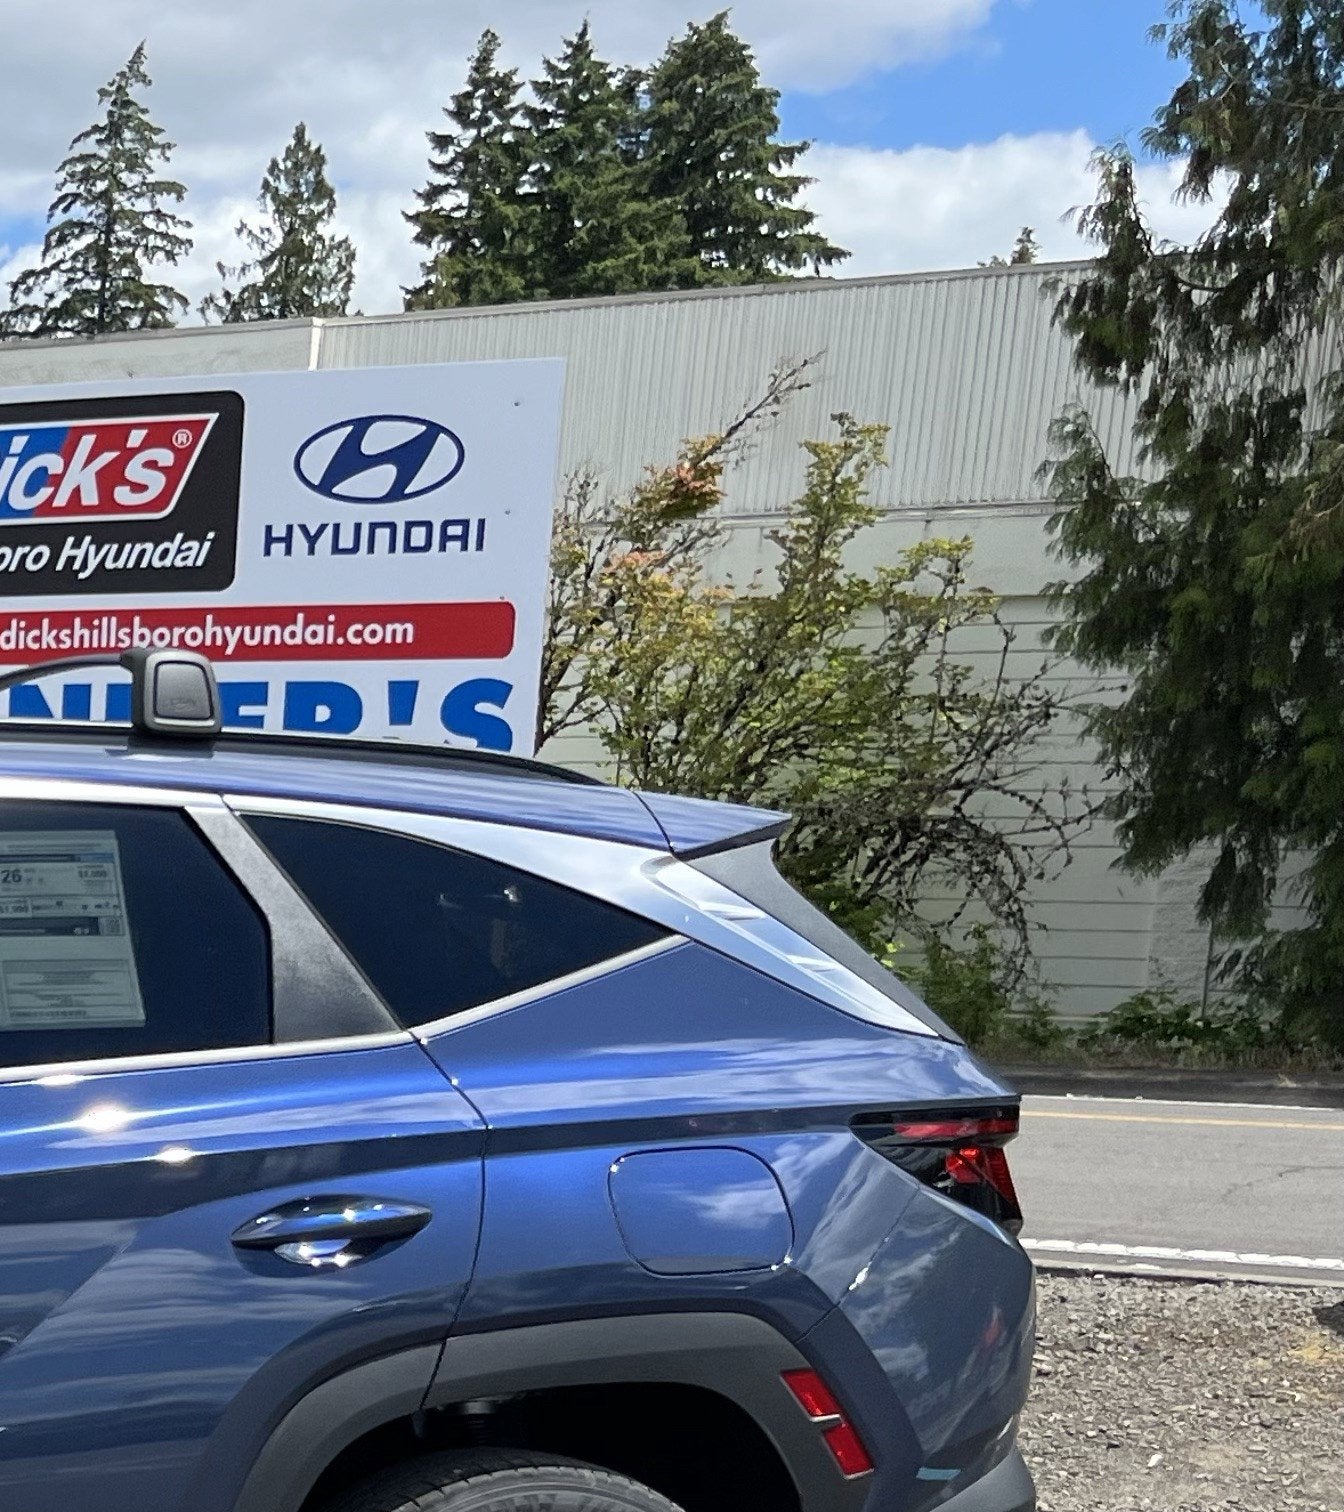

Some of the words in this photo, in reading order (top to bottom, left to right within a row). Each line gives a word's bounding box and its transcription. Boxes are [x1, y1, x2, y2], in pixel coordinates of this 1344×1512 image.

[55, 531, 217, 580] Hyundai
[262, 518, 487, 557] HYUNDAI
[0, 869, 23, 885] 26
